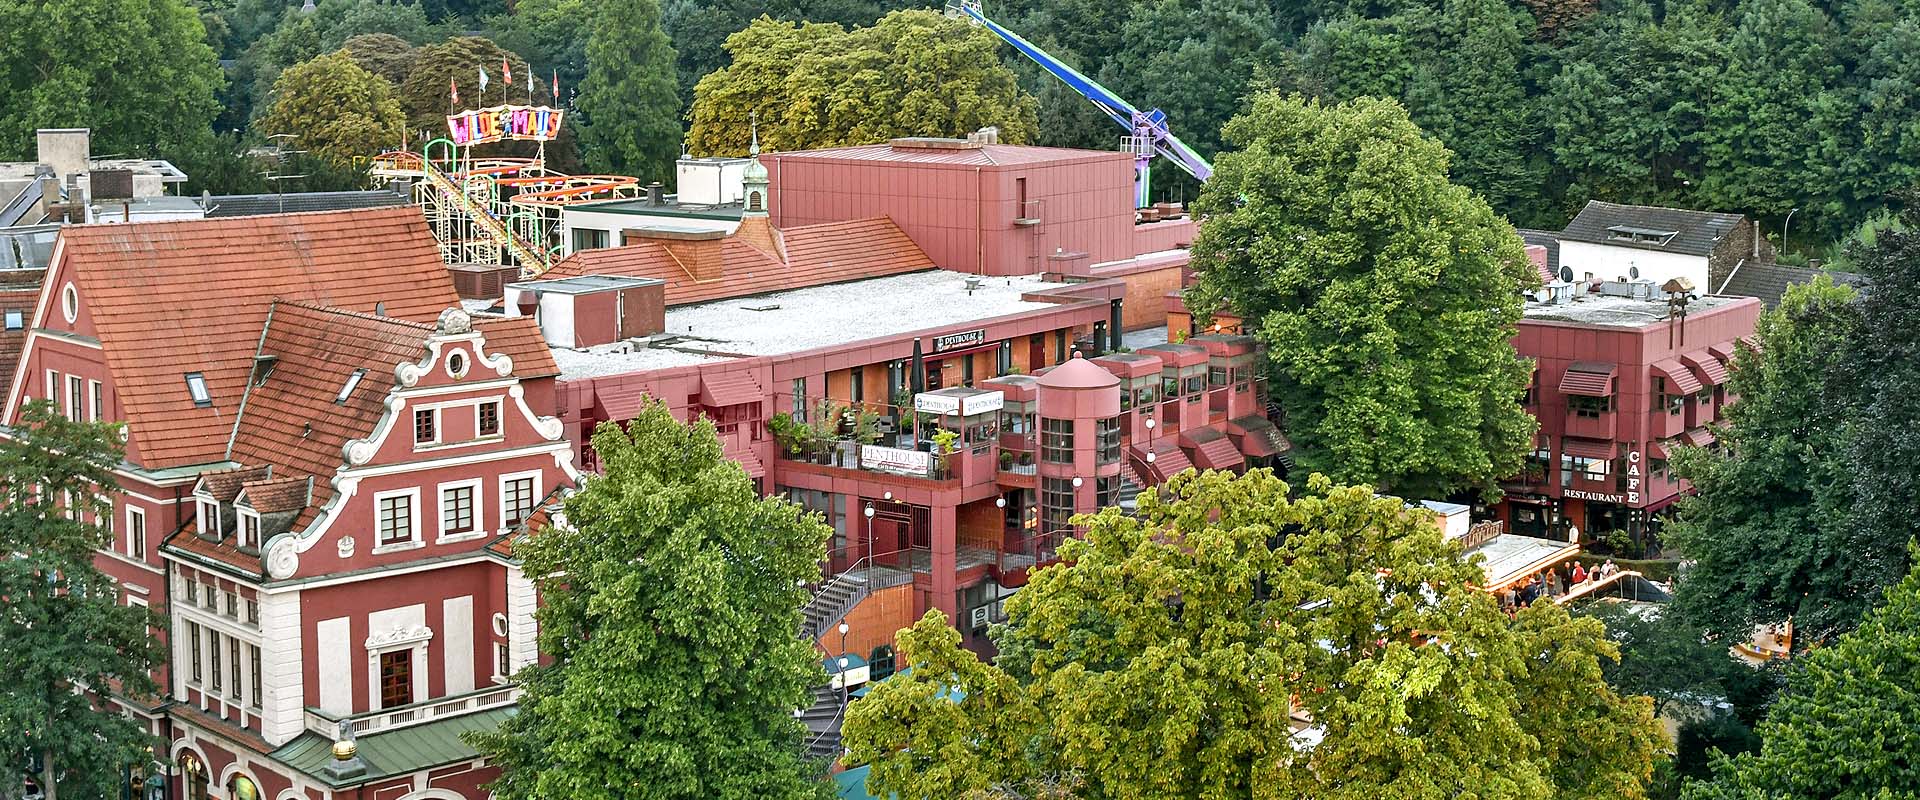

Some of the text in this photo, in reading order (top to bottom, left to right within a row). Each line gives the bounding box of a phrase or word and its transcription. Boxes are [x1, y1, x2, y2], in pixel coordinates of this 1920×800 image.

[453, 110, 558, 145] WILDE MAUS
[863, 446, 925, 465] PENTHOUSE
[1628, 451, 1640, 504] CAFE
[1563, 489, 1624, 504] RESTAURANT
